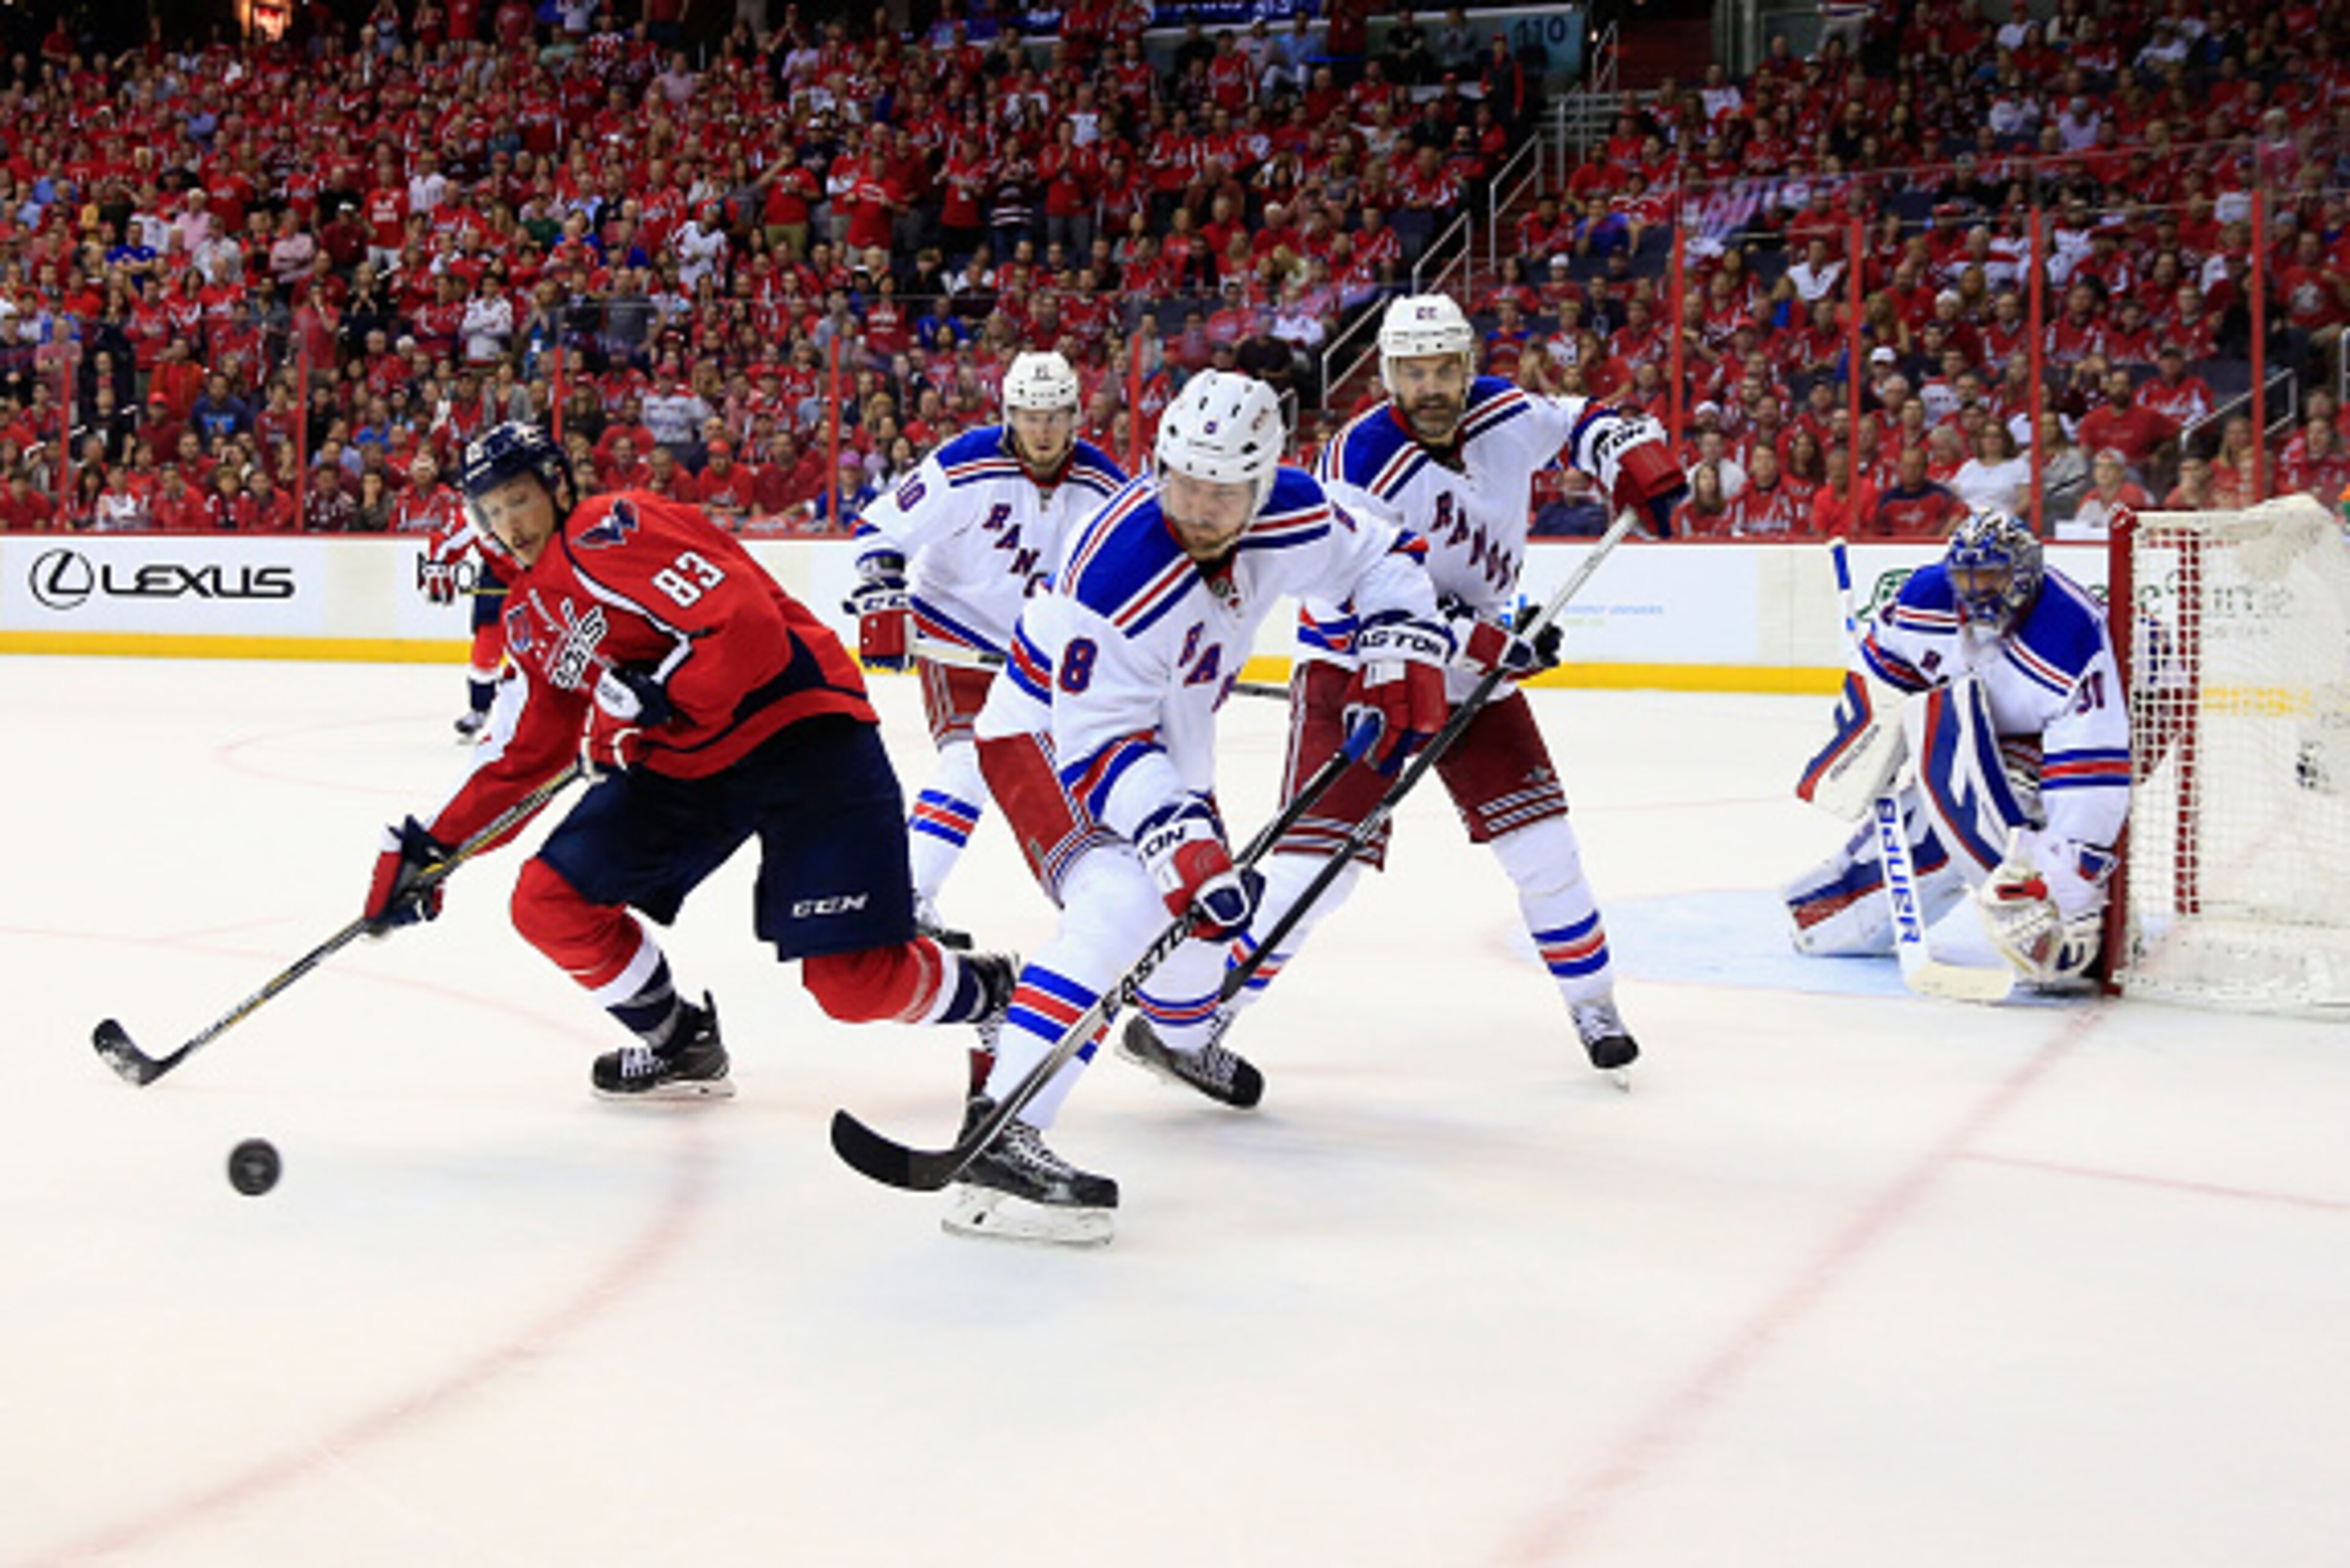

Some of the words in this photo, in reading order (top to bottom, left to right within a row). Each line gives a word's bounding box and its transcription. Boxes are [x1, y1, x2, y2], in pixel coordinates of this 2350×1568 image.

[102, 564, 295, 599] LEXUS
[652, 551, 726, 608] 83
[1059, 638, 1097, 694] 8
[1875, 797, 1920, 943] BAUER
[792, 892, 869, 918] CCM
